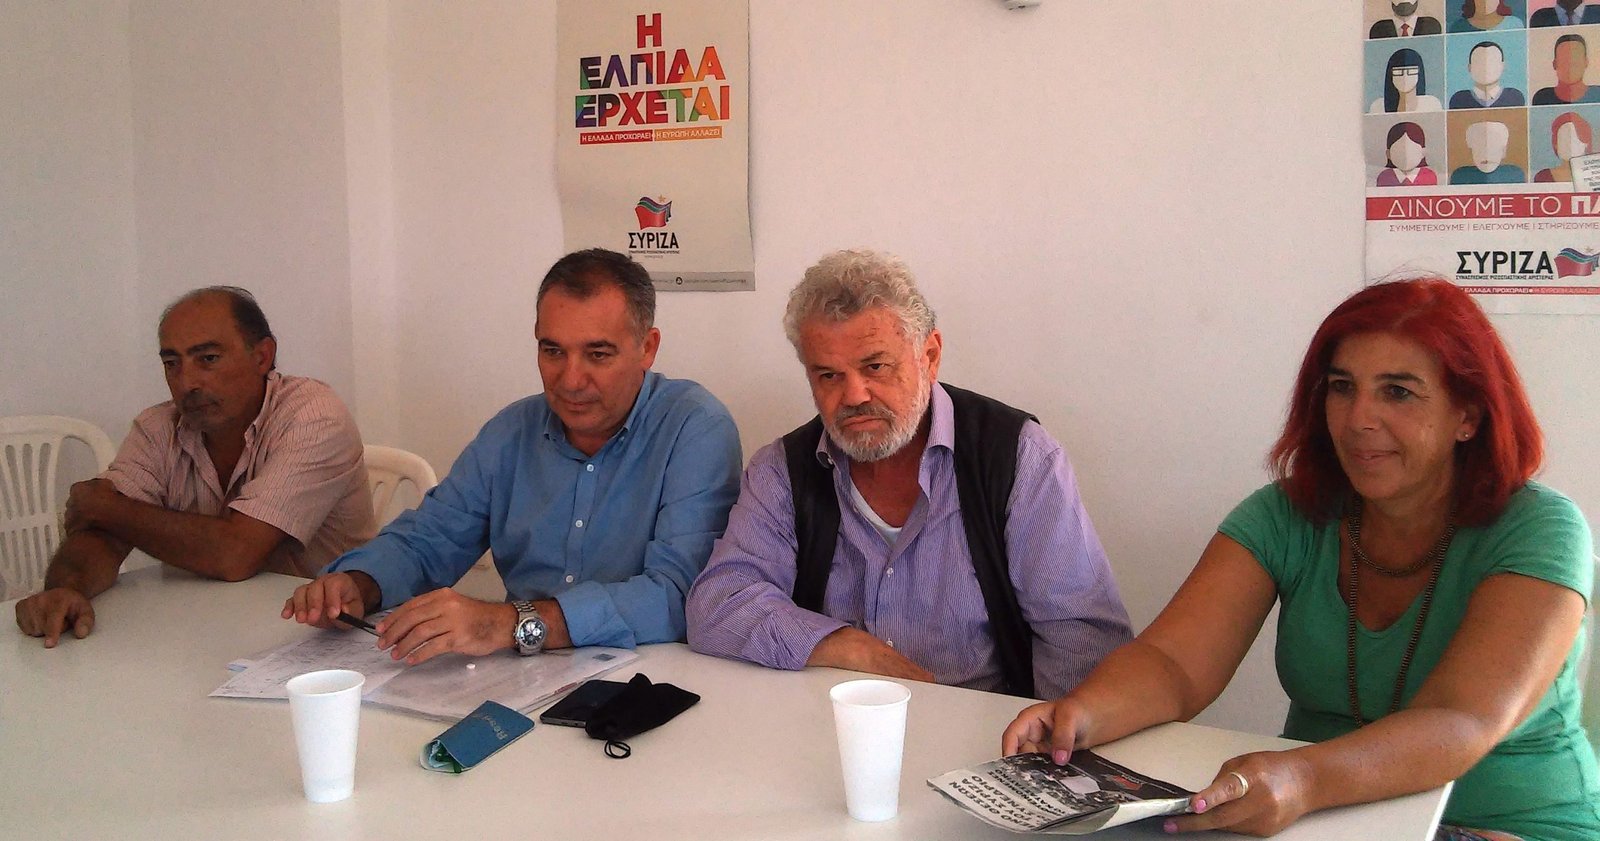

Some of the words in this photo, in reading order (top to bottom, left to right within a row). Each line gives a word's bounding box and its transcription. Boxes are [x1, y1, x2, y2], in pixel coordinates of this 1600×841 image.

[637, 13, 662, 48] Η
[580, 46, 726, 90] ΕΛΠΙΔΑ
[575, 85, 730, 128] ΕΡΧΕΤΑΙ
[1387, 197, 1513, 218] ΔΙΝΟΥΜΕ
[1524, 196, 1562, 216] ΤΟ
[1389, 223, 1465, 232] ΣΥΜΜΕΤΕΧΟΥΜΕ
[1472, 222, 1530, 231] ΕΛΕΓΧΟΥΜΕ
[628, 232, 680, 249] ΣΥΡΙΖΑ
[1456, 251, 1554, 274] ΣΥΡΙΖΑ
